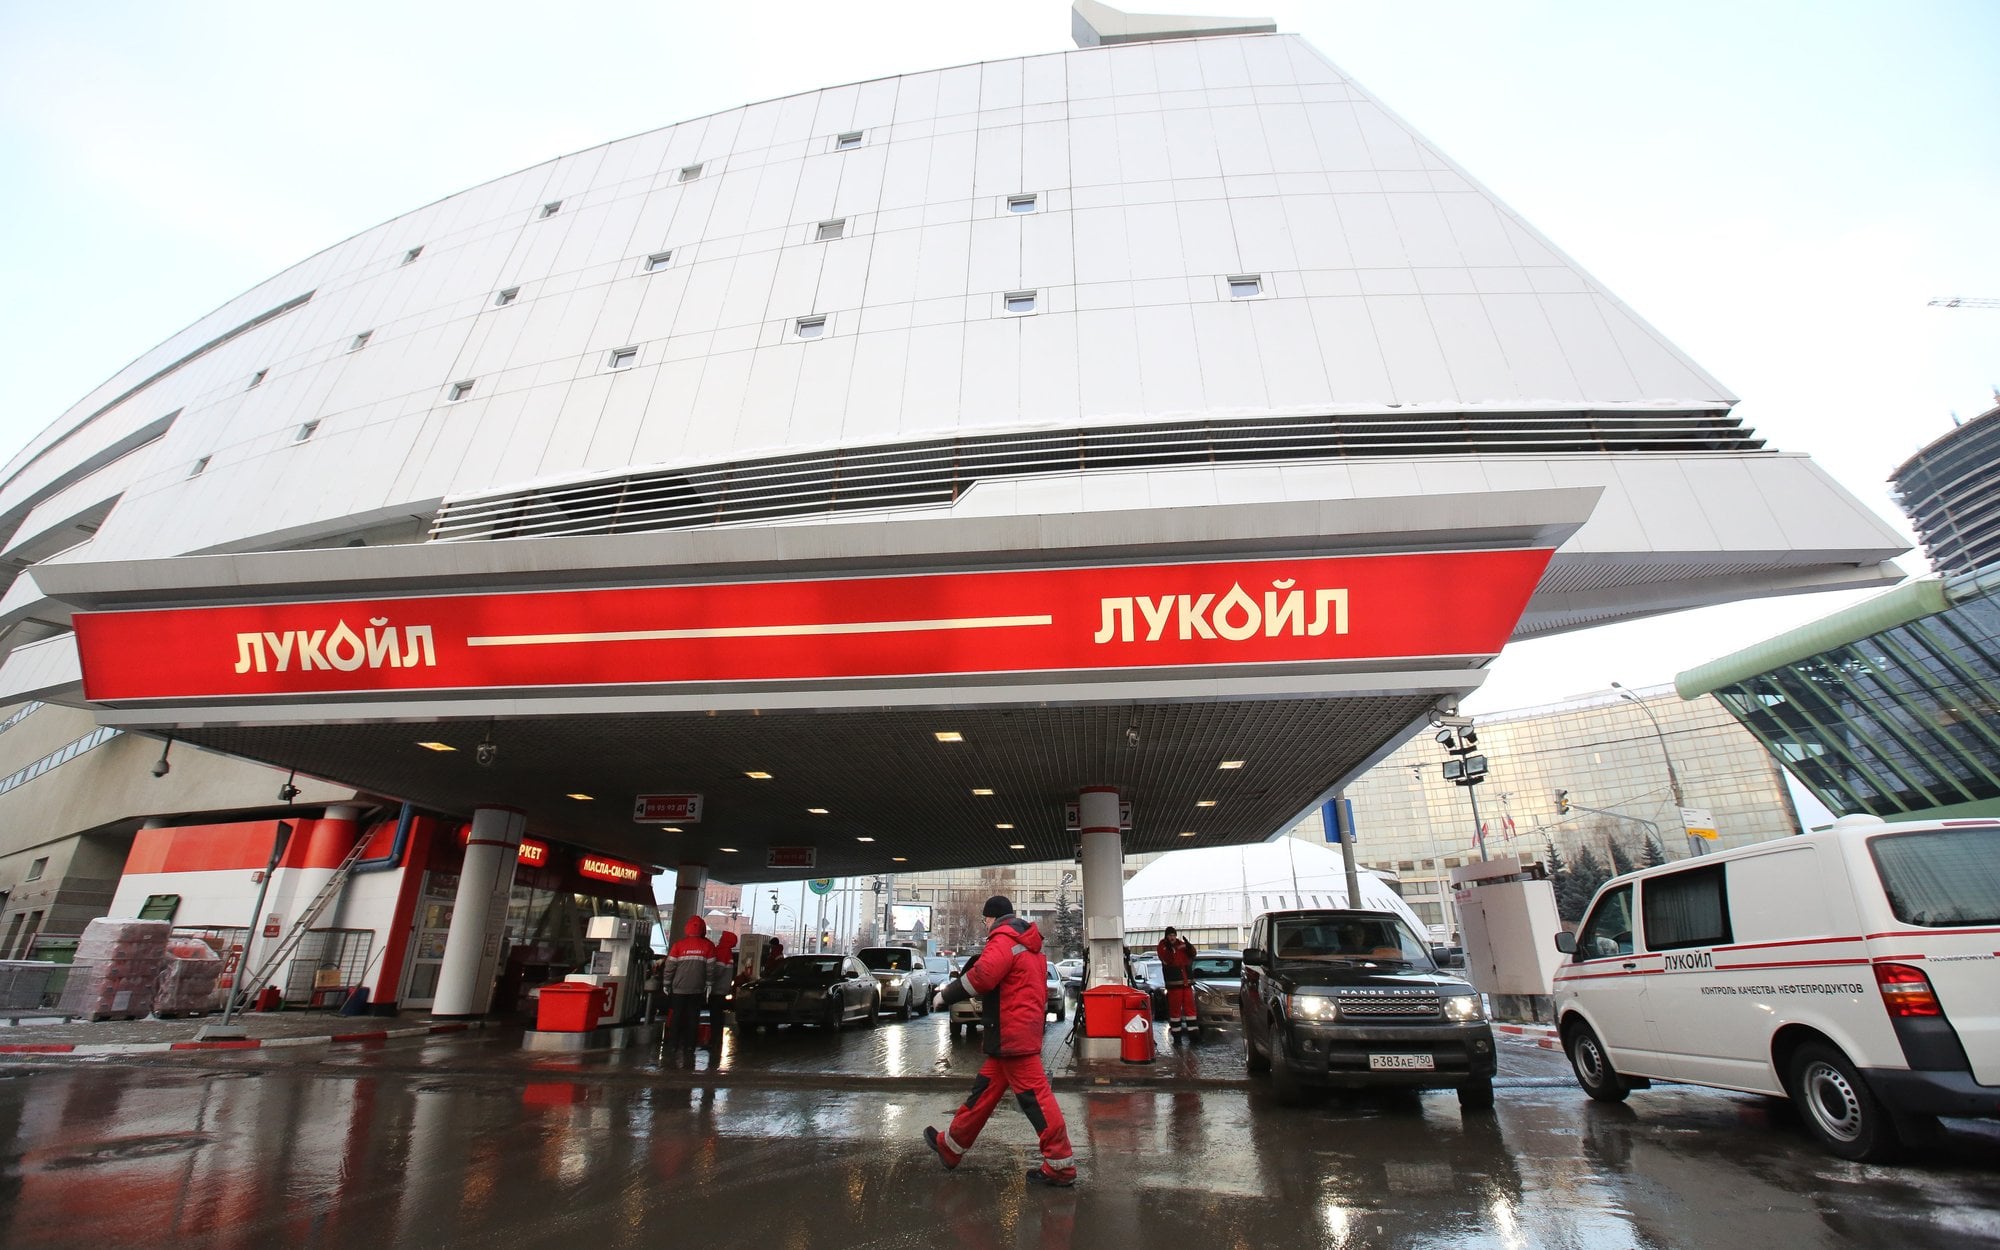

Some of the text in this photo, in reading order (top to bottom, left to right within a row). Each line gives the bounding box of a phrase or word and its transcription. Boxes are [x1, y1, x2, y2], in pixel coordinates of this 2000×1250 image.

[1094, 578, 1349, 644] ЛУКОЙЛ
[234, 616, 437, 674] ЛУКОЙЛ
[688, 803, 696, 813] 3
[1122, 811, 1129, 820] 7
[1068, 812, 1076, 821] 8
[518, 844, 542, 860] РКЕТ
[584, 859, 637, 880] МАСЛА-СМАЗКИ
[225, 956, 236, 971] 2
[1664, 950, 1713, 971] ЛУКОЙЛ
[1701, 983, 1864, 996] КОНТРОЛЬ КАЧЕСТВА НЕФТЕПРОДУКТОВ
[603, 987, 613, 1012] 3
[1414, 1055, 1431, 1064] 750
